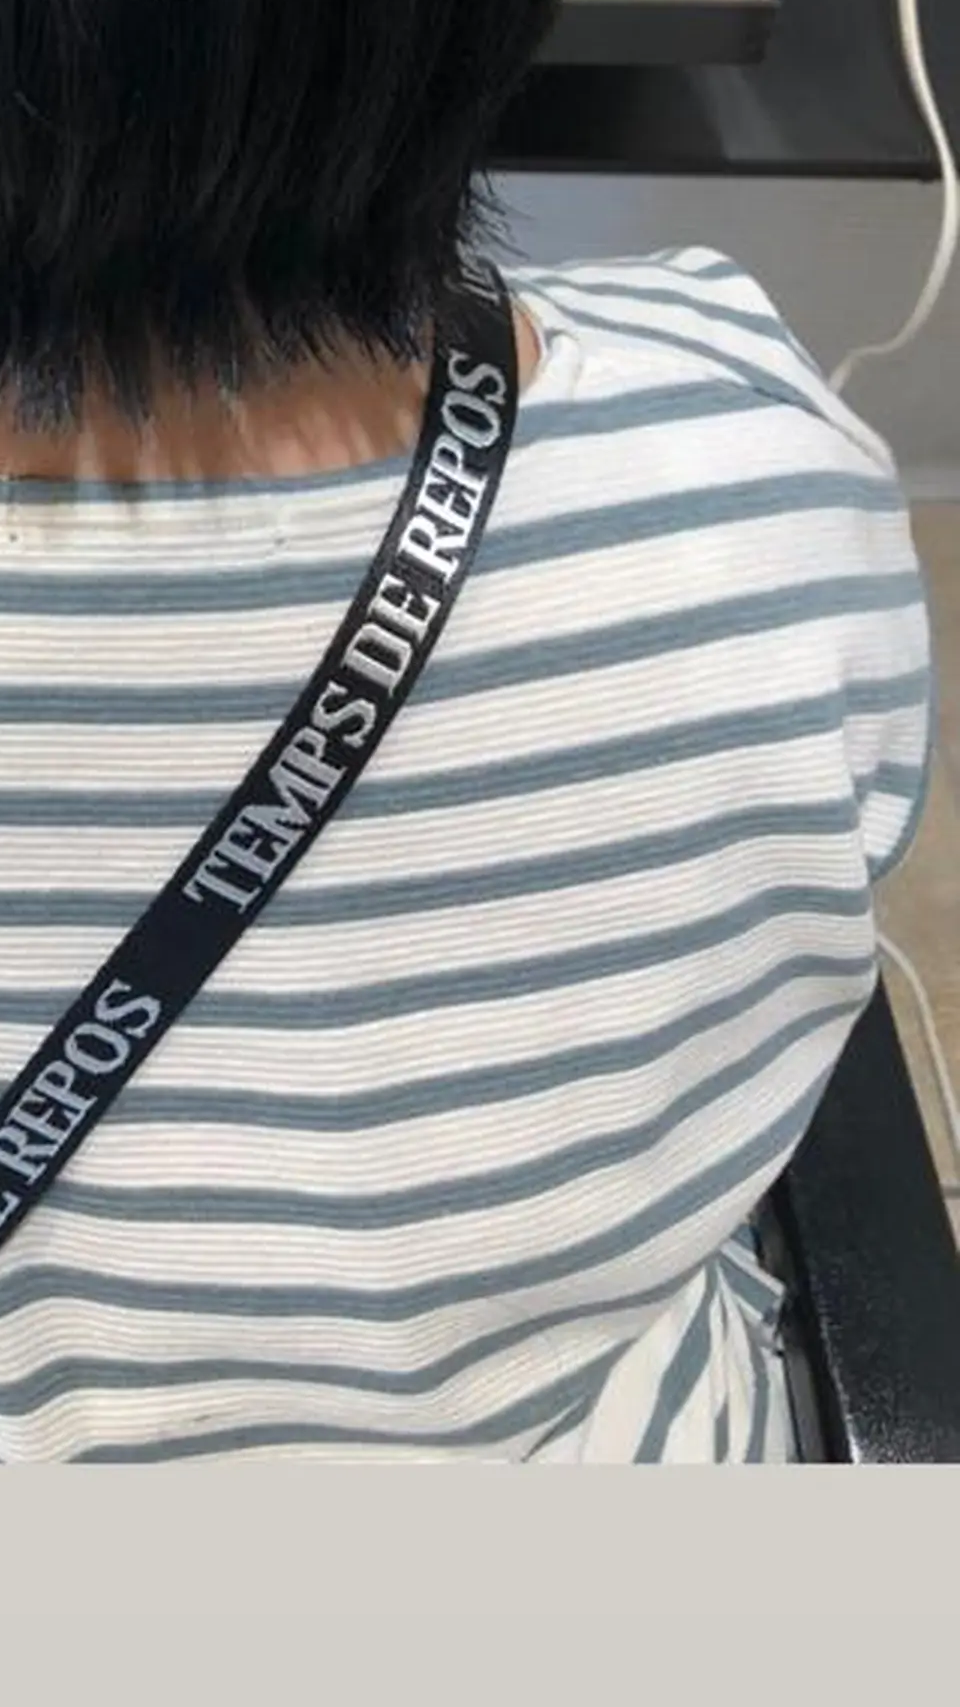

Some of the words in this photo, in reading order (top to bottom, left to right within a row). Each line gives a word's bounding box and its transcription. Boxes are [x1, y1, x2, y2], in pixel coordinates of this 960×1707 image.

[183, 685, 377, 914] TEMPS
[340, 572, 442, 698] DE
[398, 349, 508, 583] REPOS
